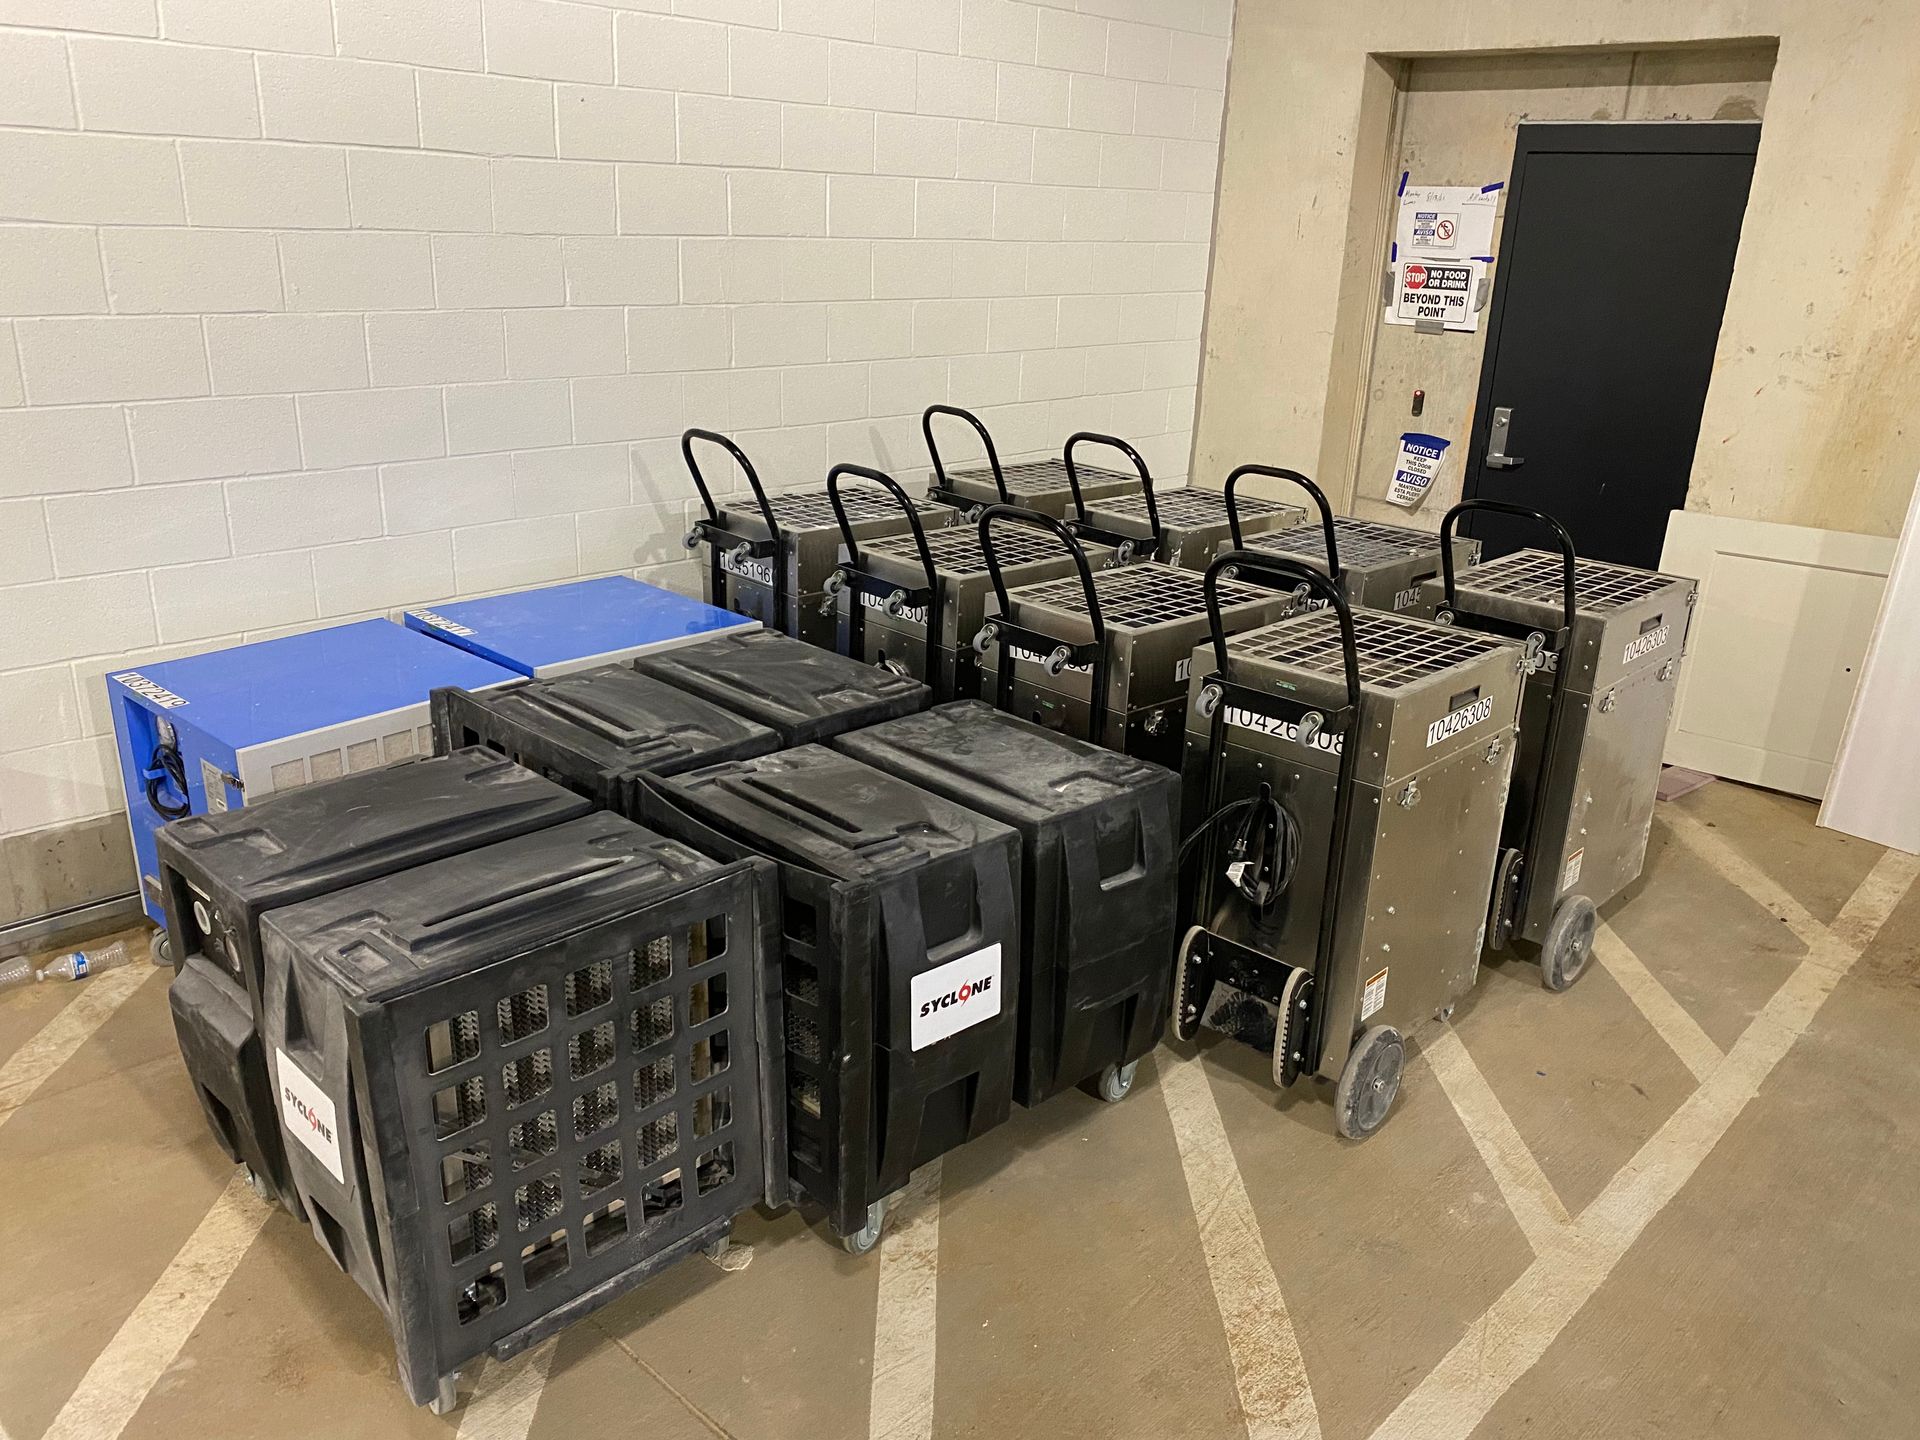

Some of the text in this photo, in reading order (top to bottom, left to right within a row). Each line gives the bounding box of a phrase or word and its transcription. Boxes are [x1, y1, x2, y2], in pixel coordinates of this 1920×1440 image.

[1406, 272, 1425, 283] STOP
[1430, 269, 1467, 280] NO FOOD
[1428, 278, 1467, 289] OR DRINK
[1403, 293, 1464, 307] BEYOND THIS
[1417, 306, 1446, 318] POINT
[1406, 443, 1438, 458] NOTICE
[1407, 465, 1427, 475] CLOSED
[1417, 462, 1432, 470] DOOR
[1399, 472, 1428, 486] AVISO
[1624, 628, 1668, 662] 10426303
[116, 673, 186, 708] 10372419
[1429, 697, 1492, 744] 10426308
[1226, 705, 1344, 754] 1042608
[920, 976, 993, 1018] SYCLONE
[284, 1087, 332, 1144] SYCLONE
